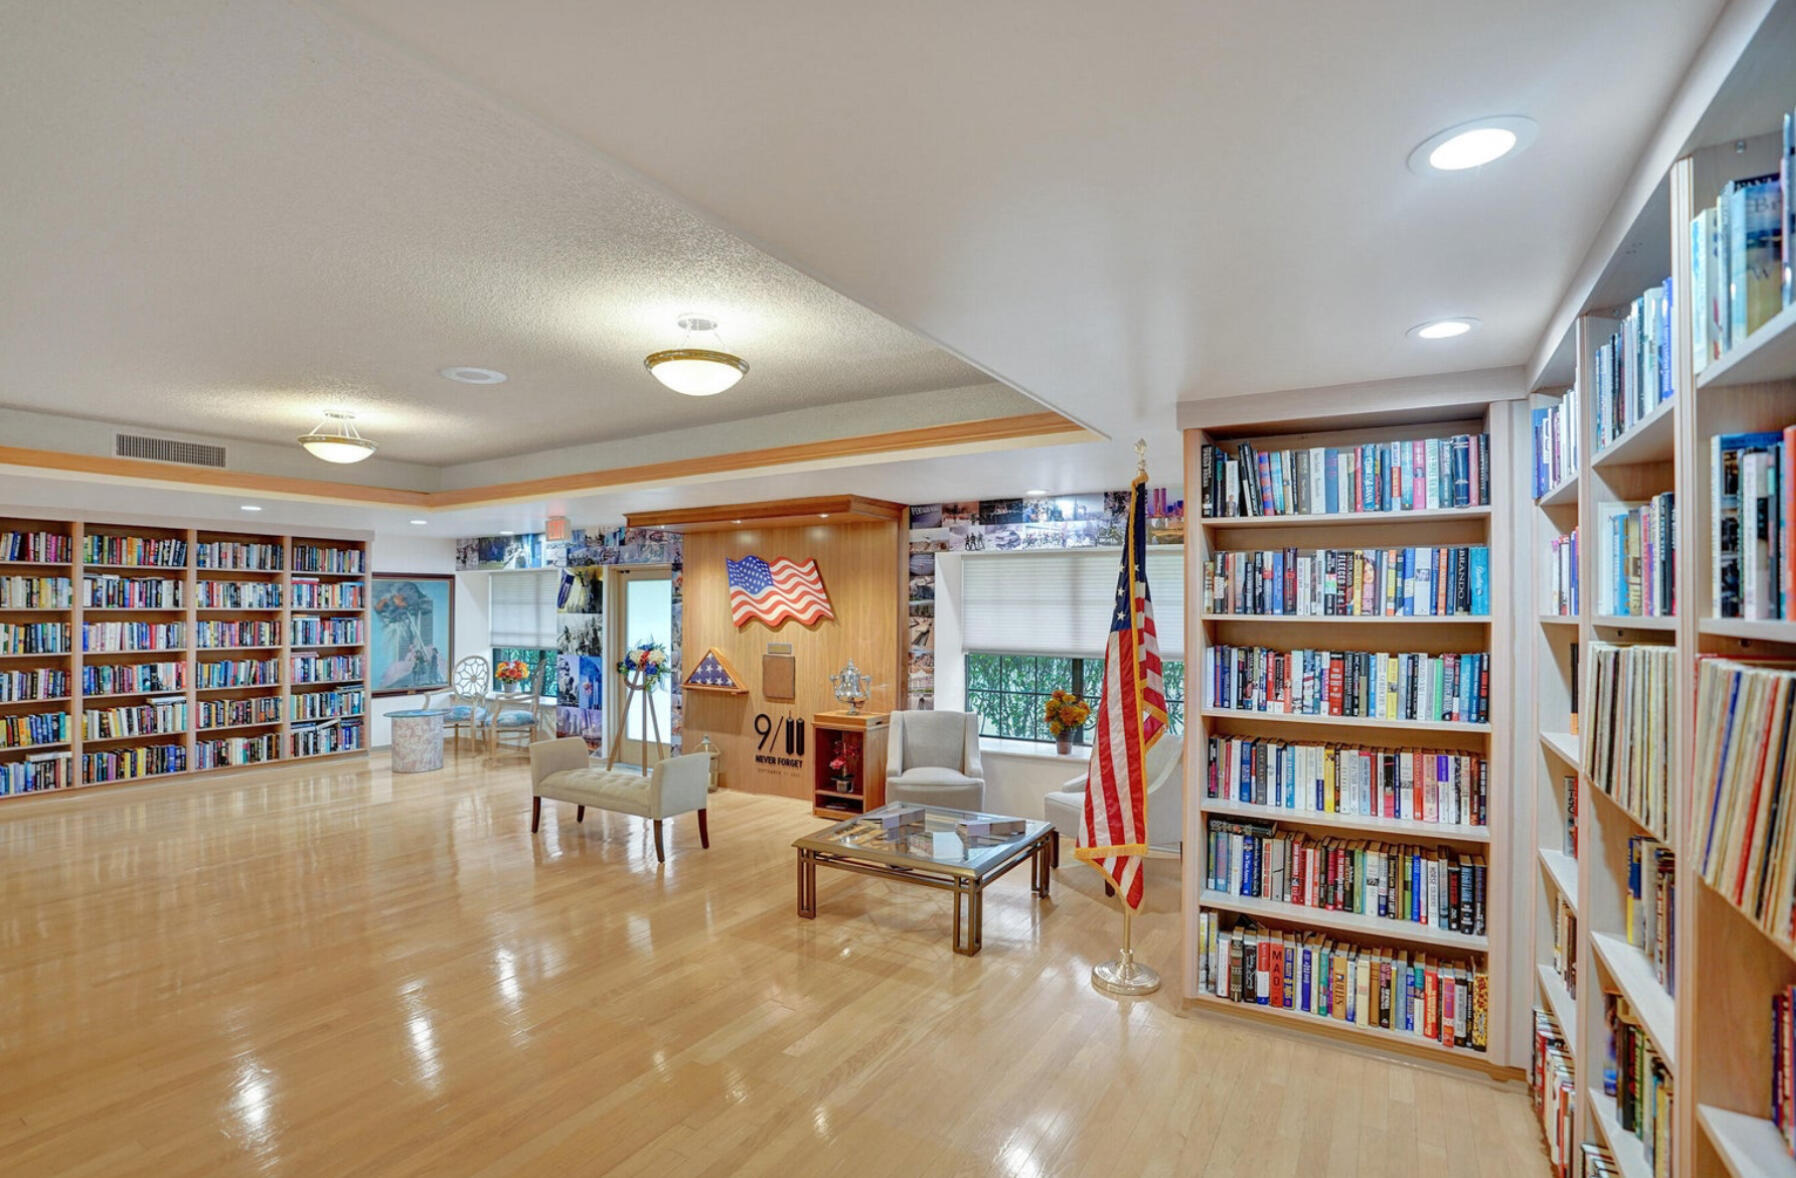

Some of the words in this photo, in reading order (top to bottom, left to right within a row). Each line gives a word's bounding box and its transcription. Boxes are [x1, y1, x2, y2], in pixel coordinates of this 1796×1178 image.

[754, 712, 805, 756] 9/11
[755, 755, 776, 764] NEVER
[777, 757, 803, 768] FORGET
[1272, 950, 1281, 988] MAD
